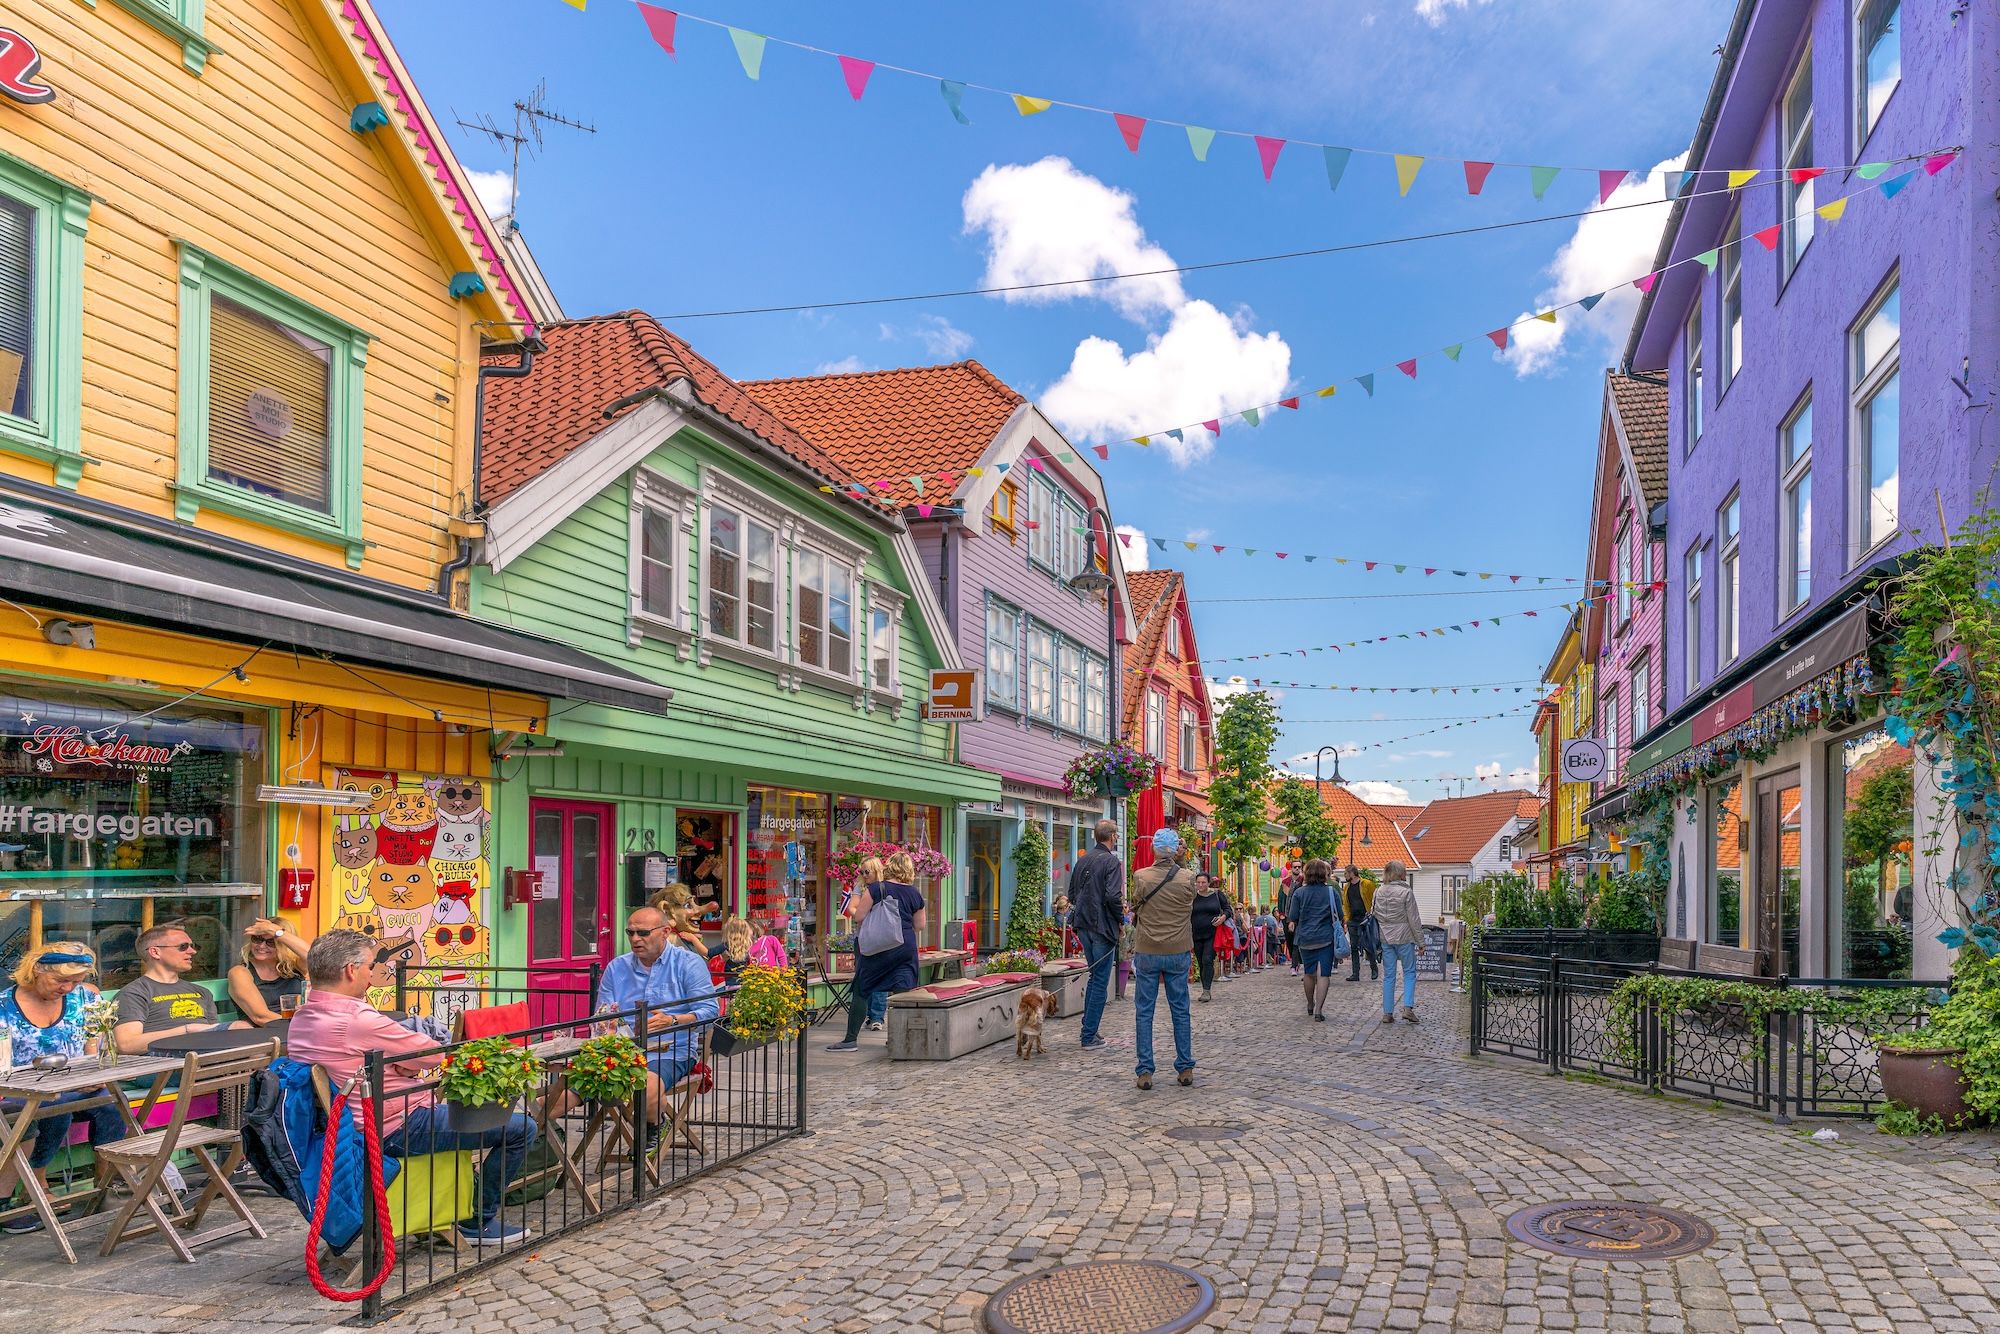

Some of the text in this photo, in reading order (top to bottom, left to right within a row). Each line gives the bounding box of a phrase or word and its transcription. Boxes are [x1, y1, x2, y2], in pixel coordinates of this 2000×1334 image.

[252, 393, 289, 412] ANETTE
[262, 405, 280, 418] MOI
[255, 412, 287, 429] STUDIO
[931, 710, 973, 719] BERNINA
[116, 763, 172, 773] STAVANGER
[0, 805, 213, 841] #fargegaten
[760, 814, 816, 832] #fargegaten
[384, 834, 415, 842] ANETTE
[626, 827, 656, 852] 28
[394, 842, 407, 850] MOI
[389, 850, 414, 858] STUDIO
[434, 861, 477, 873] CHICAGO
[444, 871, 471, 880] BULLS
[747, 879, 778, 890] SINGER
[386, 912, 422, 928] GUCCI
